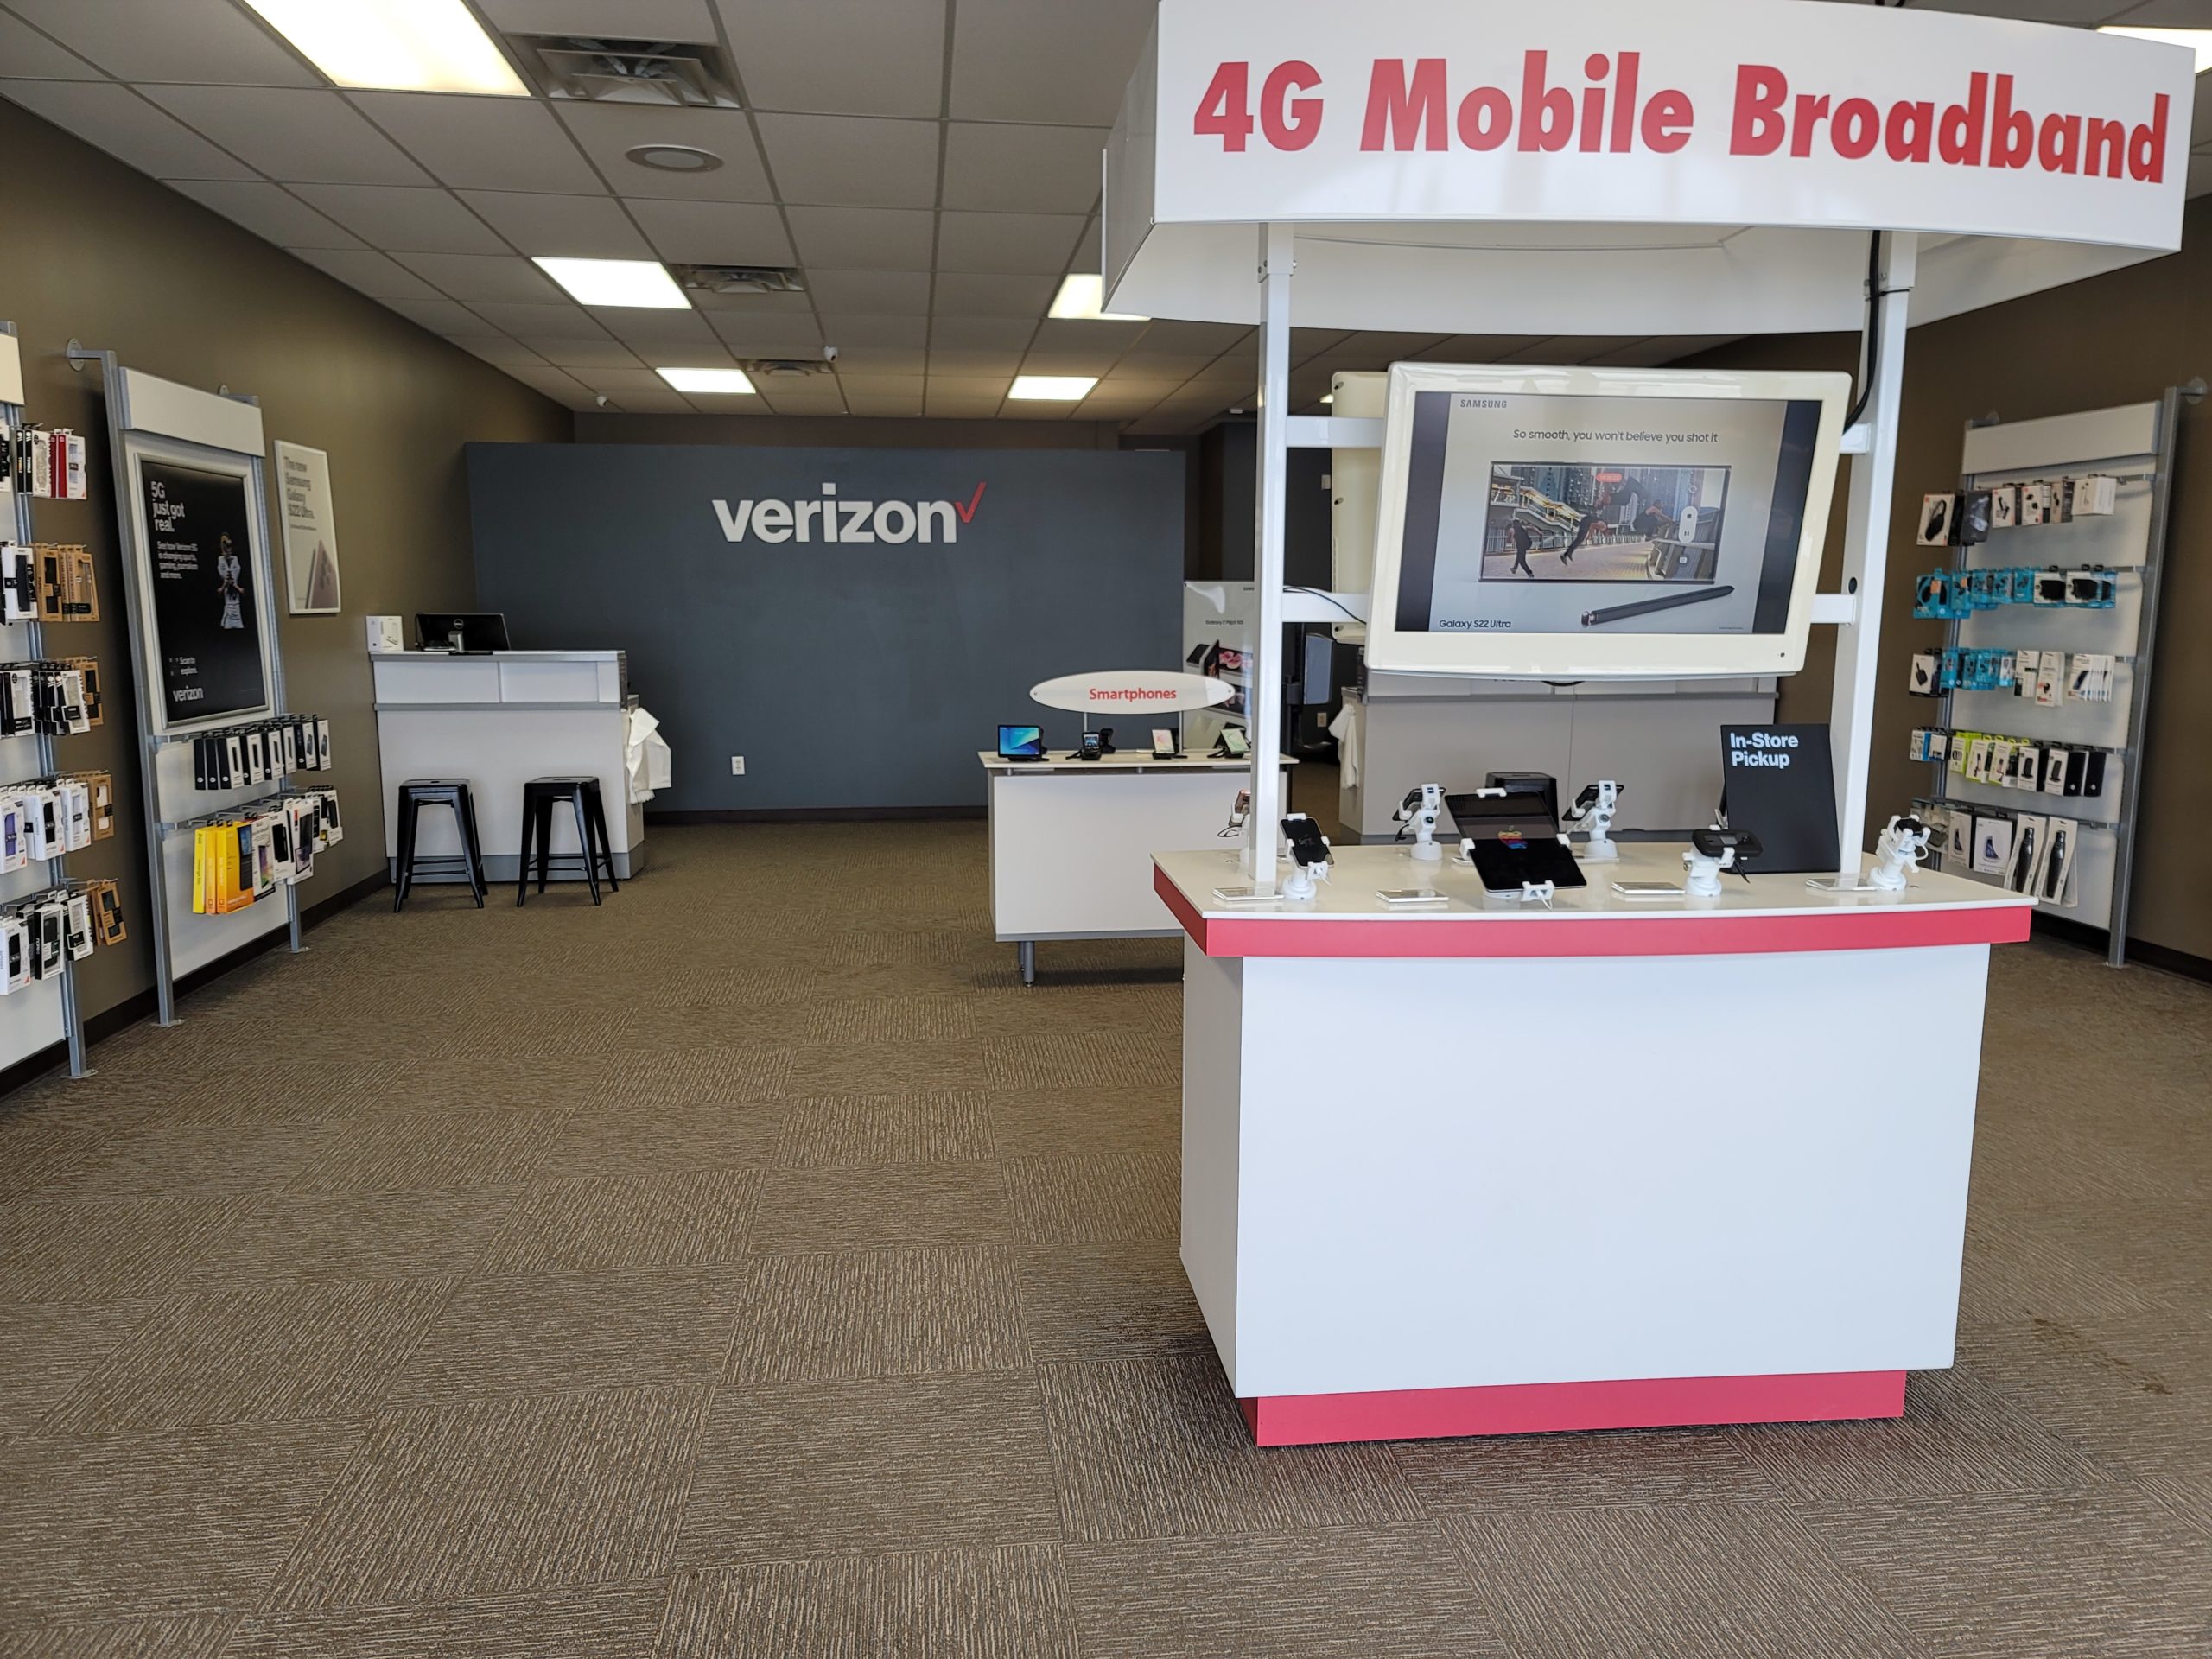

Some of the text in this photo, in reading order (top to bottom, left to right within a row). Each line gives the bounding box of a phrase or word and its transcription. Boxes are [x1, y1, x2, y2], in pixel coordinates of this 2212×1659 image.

[1193, 49, 2171, 185] 4G Mobile Broadband
[1459, 398, 1508, 409] SAMSUNG
[1513, 429, 1719, 444] So smooth, you won't believe you shot it
[150, 481, 165, 499] 5G
[152, 499, 186, 520] just got
[711, 482, 957, 544] verizon
[155, 516, 175, 532] real.
[1439, 620, 1511, 629] Galaxy S22 Ultra
[173, 684, 204, 702] verizon
[1089, 687, 1177, 702] Smartphones
[1730, 731, 1799, 748] In-Store
[1731, 749, 1790, 770] Pickup
